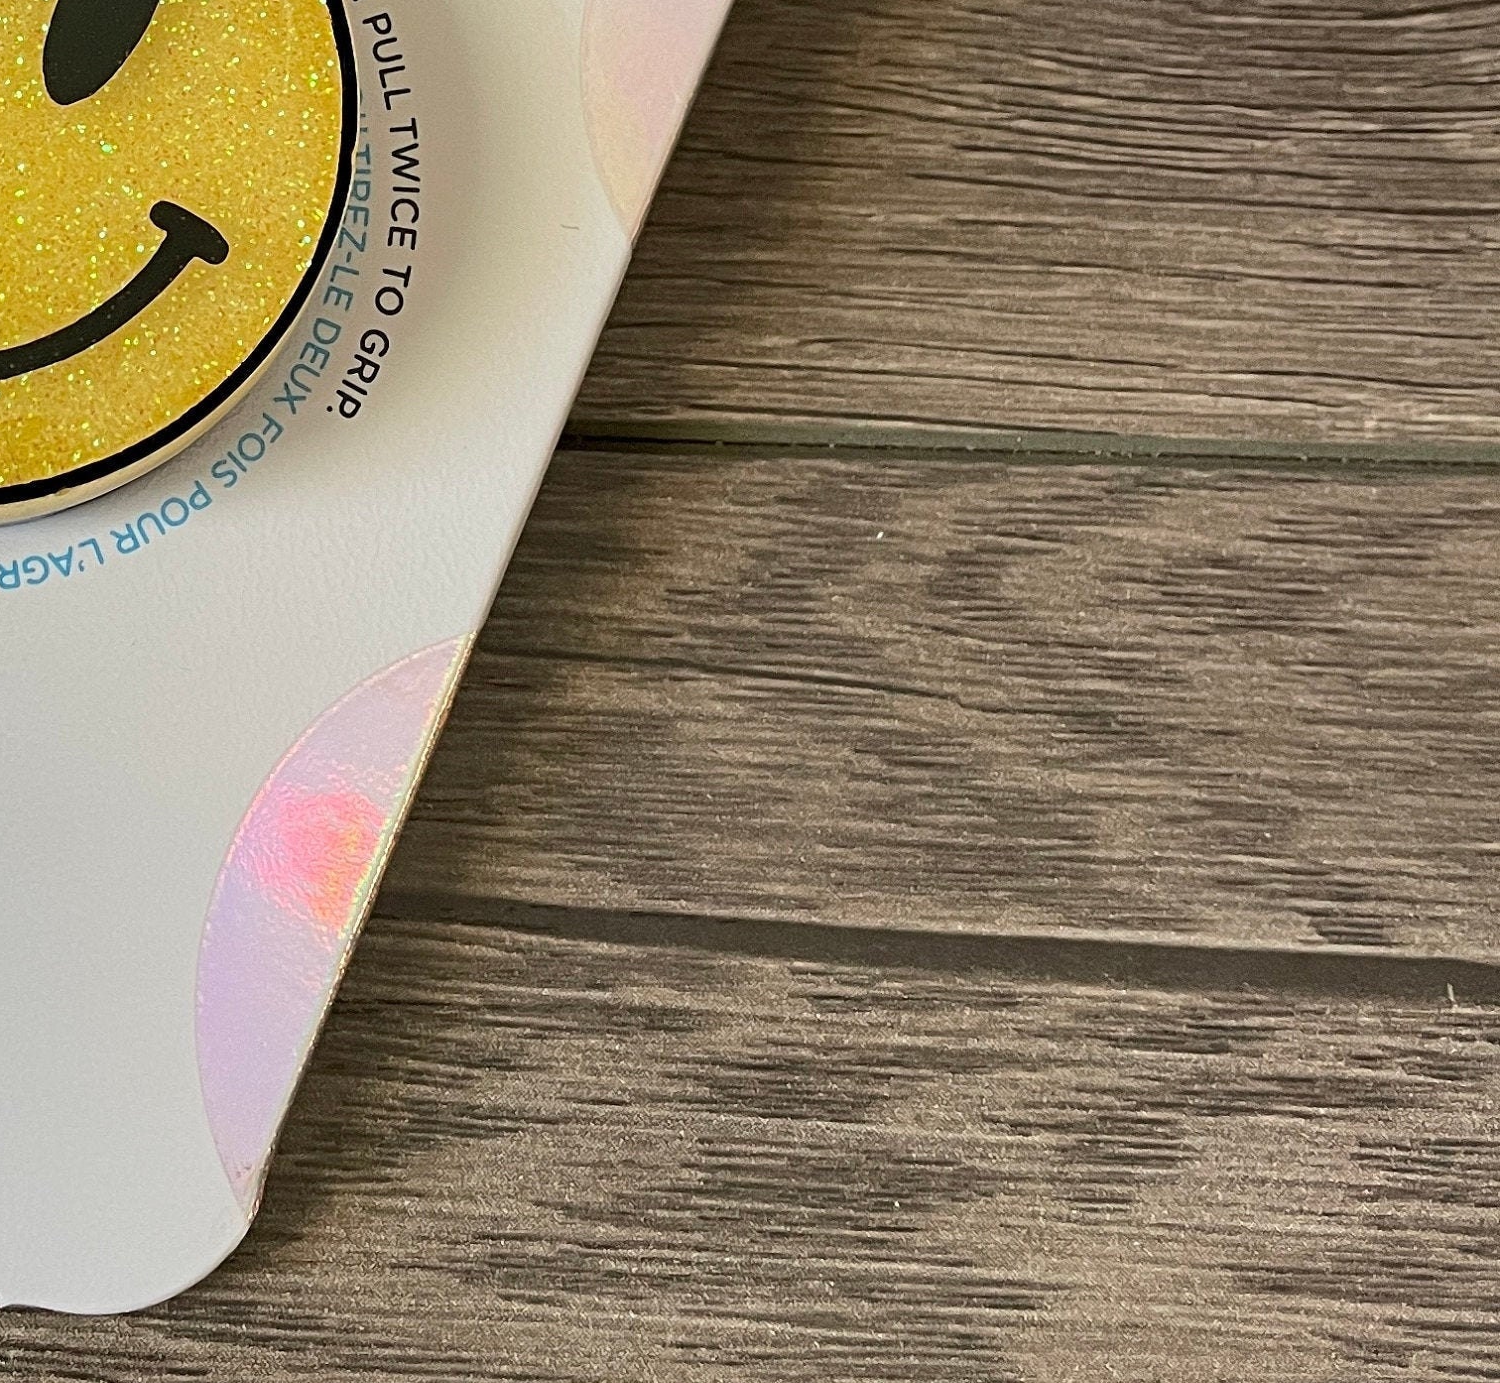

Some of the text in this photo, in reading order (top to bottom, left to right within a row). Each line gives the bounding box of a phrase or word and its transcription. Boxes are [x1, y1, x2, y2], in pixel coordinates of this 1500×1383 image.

[362, 13, 411, 110] PULL
[388, 118, 420, 250] TWICE
[375, 266, 411, 316] TO
[274, 318, 341, 414] DEUX
[326, 329, 389, 419] GRIP.
[211, 413, 284, 488] FOIS
[110, 480, 213, 554] POUR
